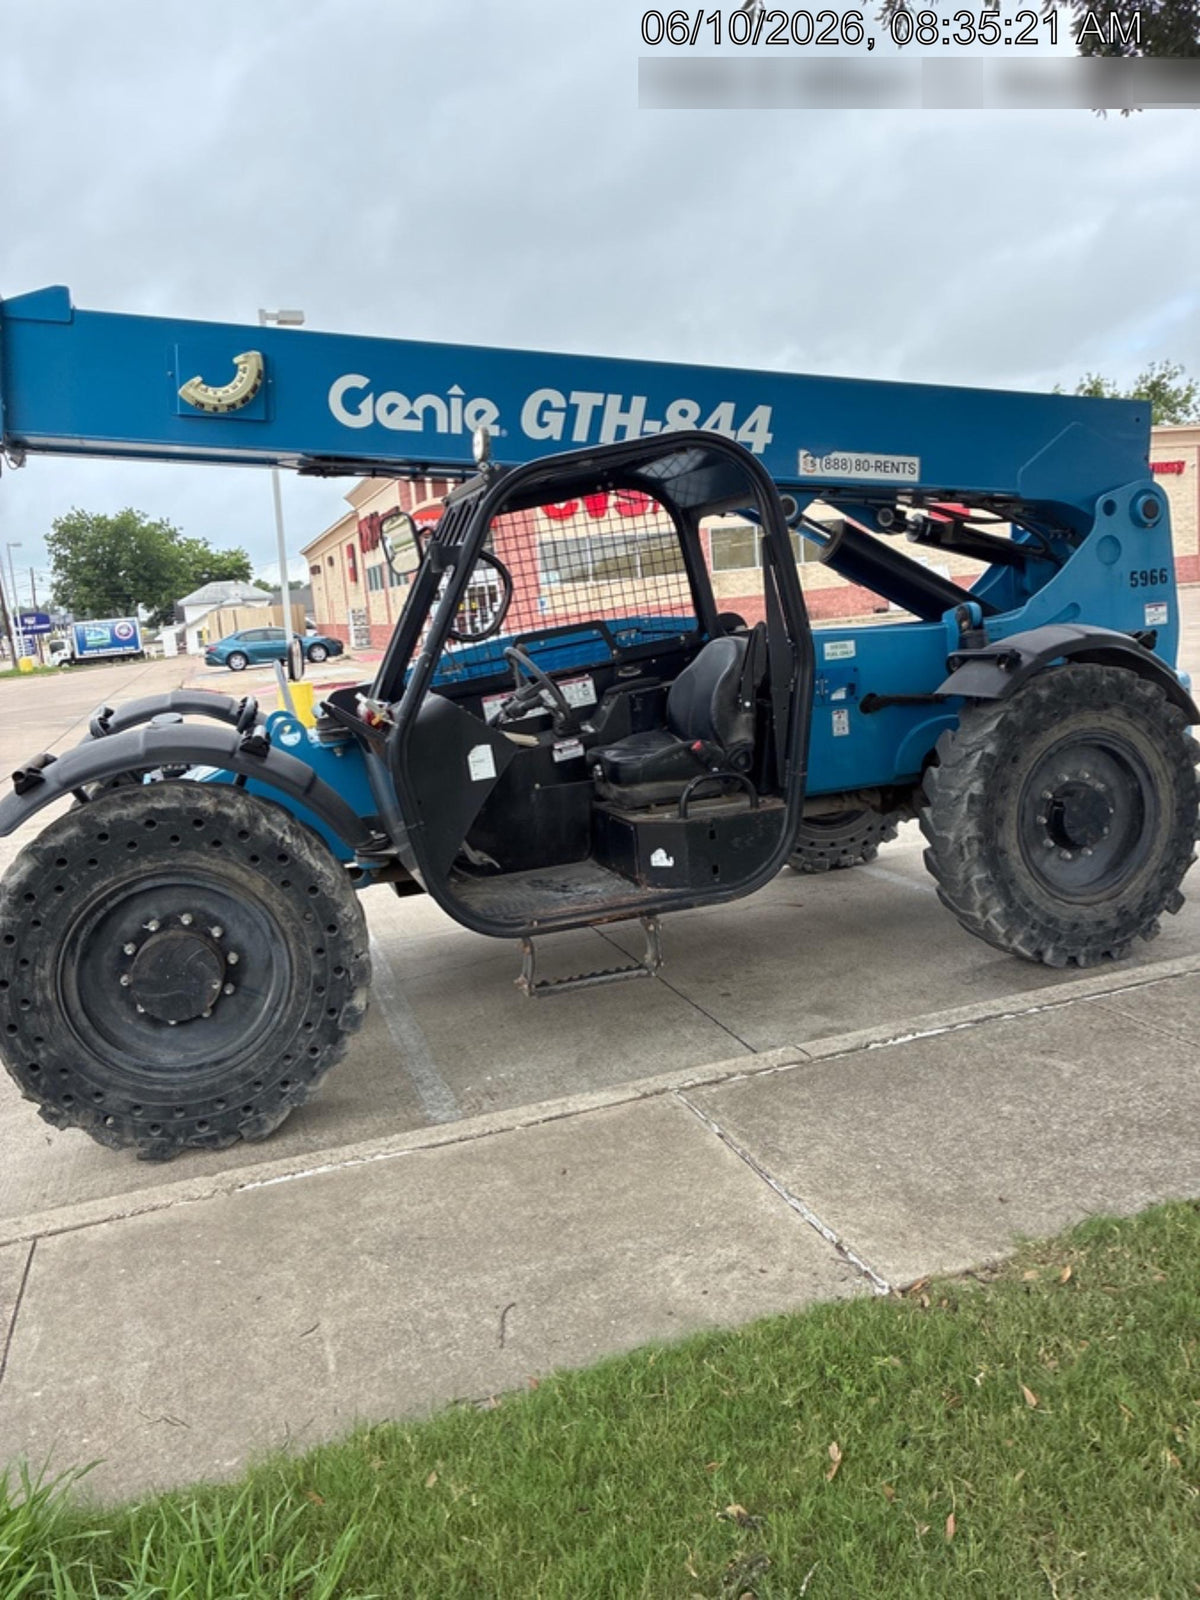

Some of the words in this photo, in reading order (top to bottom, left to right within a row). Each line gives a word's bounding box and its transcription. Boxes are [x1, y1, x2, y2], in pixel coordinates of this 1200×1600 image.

[328, 374, 500, 435] Genie
[520, 388, 774, 454] GTH-844
[1130, 568, 1168, 588] 5966
